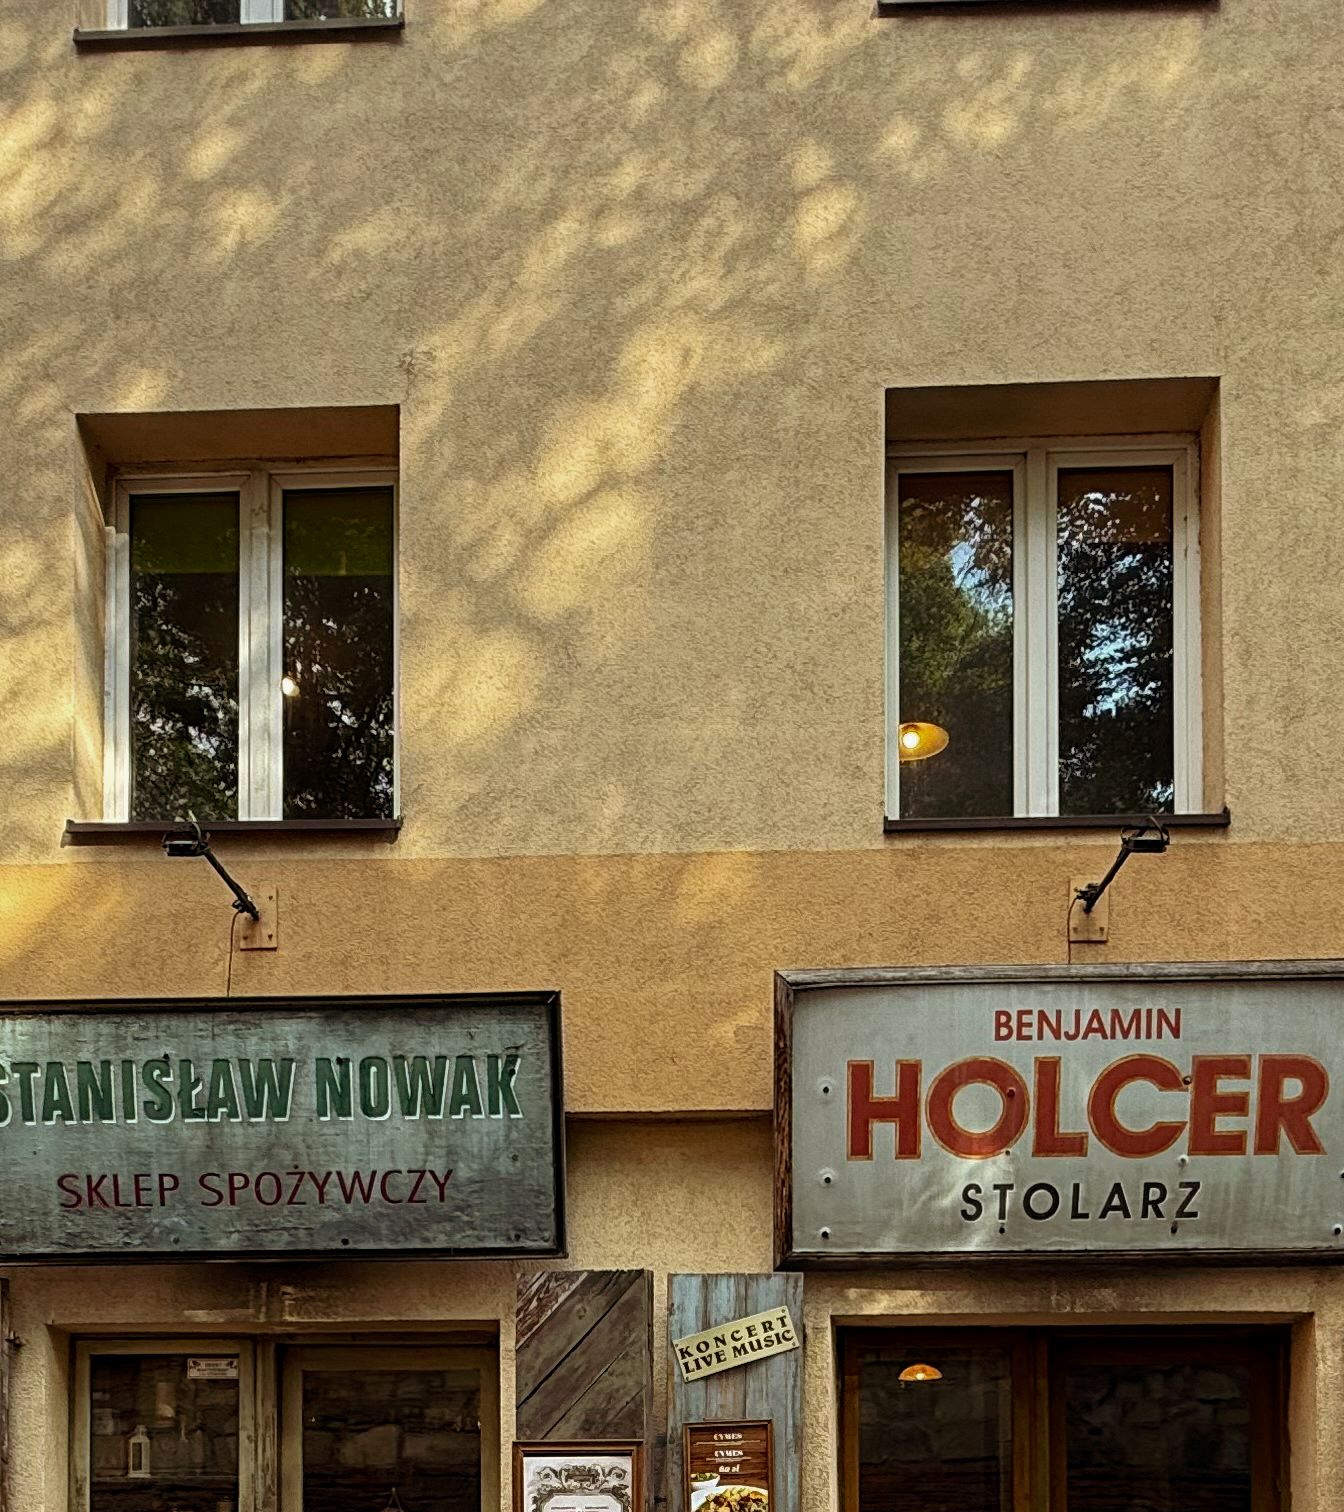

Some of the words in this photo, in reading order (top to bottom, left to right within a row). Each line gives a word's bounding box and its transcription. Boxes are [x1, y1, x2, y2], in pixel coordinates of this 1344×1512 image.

[994, 1007, 1182, 1042] BENJAMIN
[316, 1053, 525, 1122] NOWAK
[845, 1052, 1330, 1161] HOLCER
[57, 1172, 181, 1209] SKLEP
[199, 1163, 454, 1208] SPOŻYWCZY
[960, 1181, 1202, 1222] STOLARZ
[679, 1315, 788, 1361] KONCERT
[683, 1350, 727, 1375] LIVE
[733, 1329, 795, 1358] MUSIC
